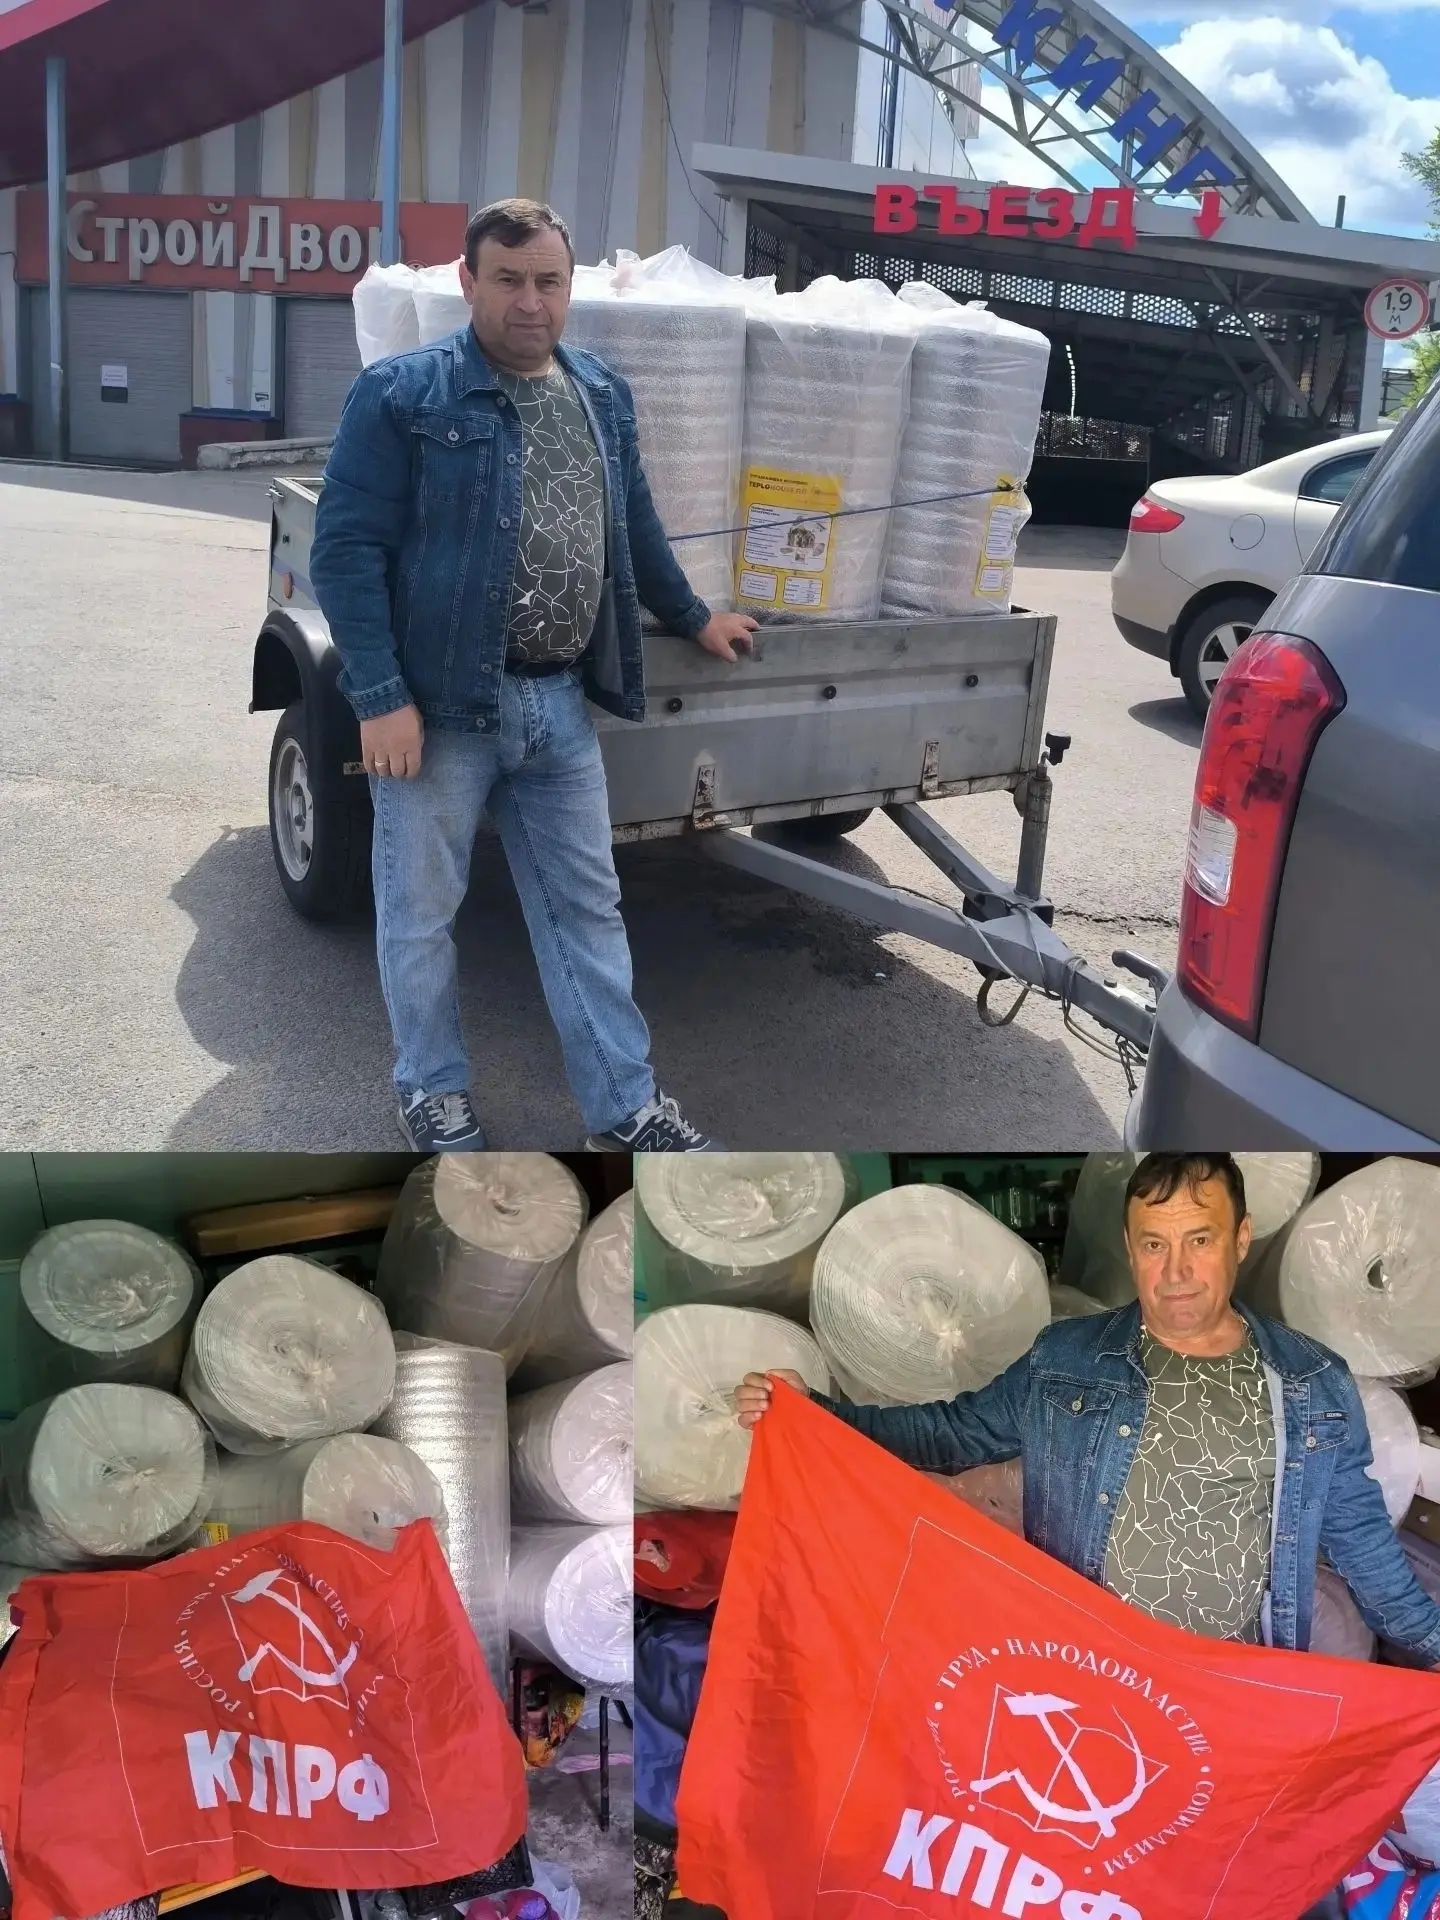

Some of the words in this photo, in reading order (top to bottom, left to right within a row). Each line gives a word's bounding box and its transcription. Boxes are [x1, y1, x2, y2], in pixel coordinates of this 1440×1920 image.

[934, 0, 1236, 194] КИНГ
[873, 184, 1137, 250] ВЪЕЗД
[174, 1639, 241, 1712] РОССИЯ
[936, 1646, 991, 1691] ТРУД
[1006, 1638, 1213, 1756] НАРОДОВЛАСТИЕ
[184, 1730, 389, 1821] КПРФ
[1103, 1780, 1215, 1876] СОЦИАЛИЗМ
